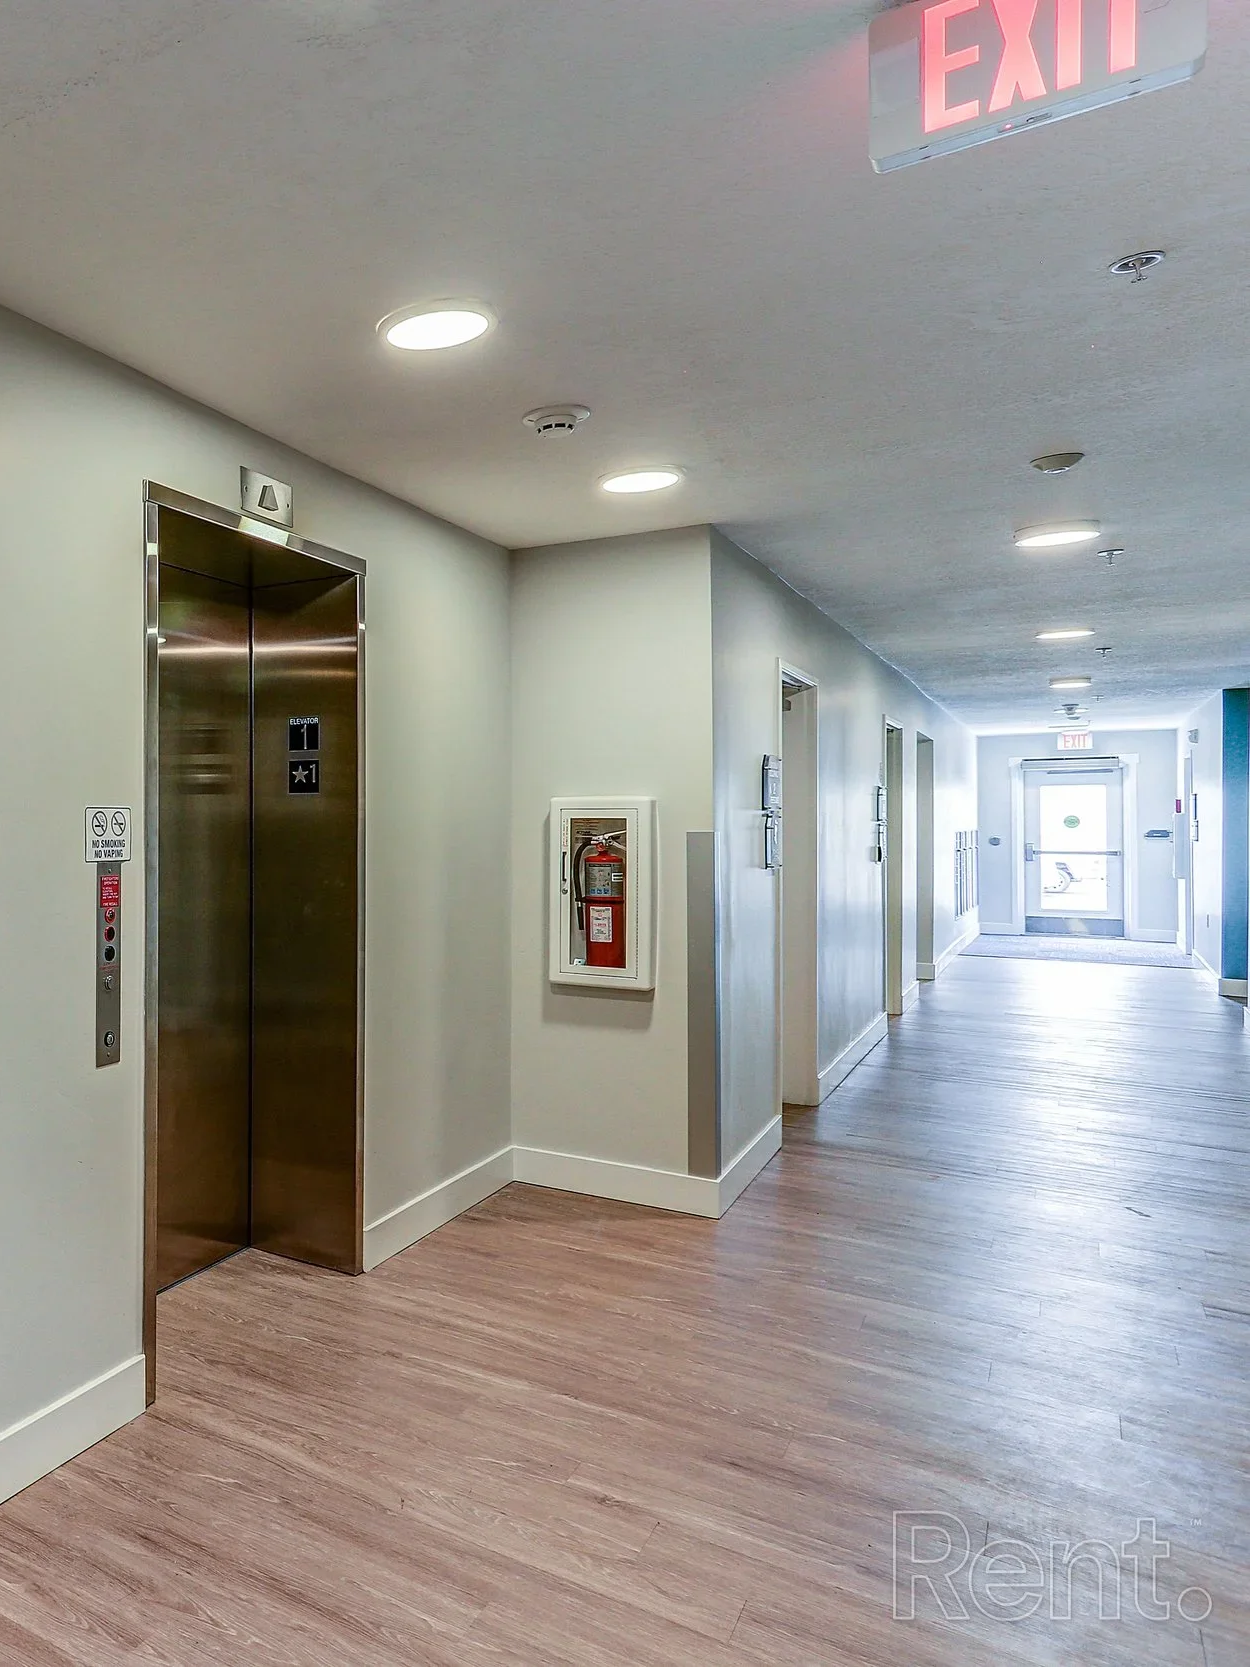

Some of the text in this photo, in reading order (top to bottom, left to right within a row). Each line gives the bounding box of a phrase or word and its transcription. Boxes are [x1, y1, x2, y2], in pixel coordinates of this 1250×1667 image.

[290, 717, 319, 725] ELEVATOR
[301, 724, 307, 750] 1
[1063, 734, 1087, 748] EXIT
[310, 763, 316, 783] 1
[91, 839, 126, 848] NO SMOKING
[94, 849, 124, 858] NO VAPING
